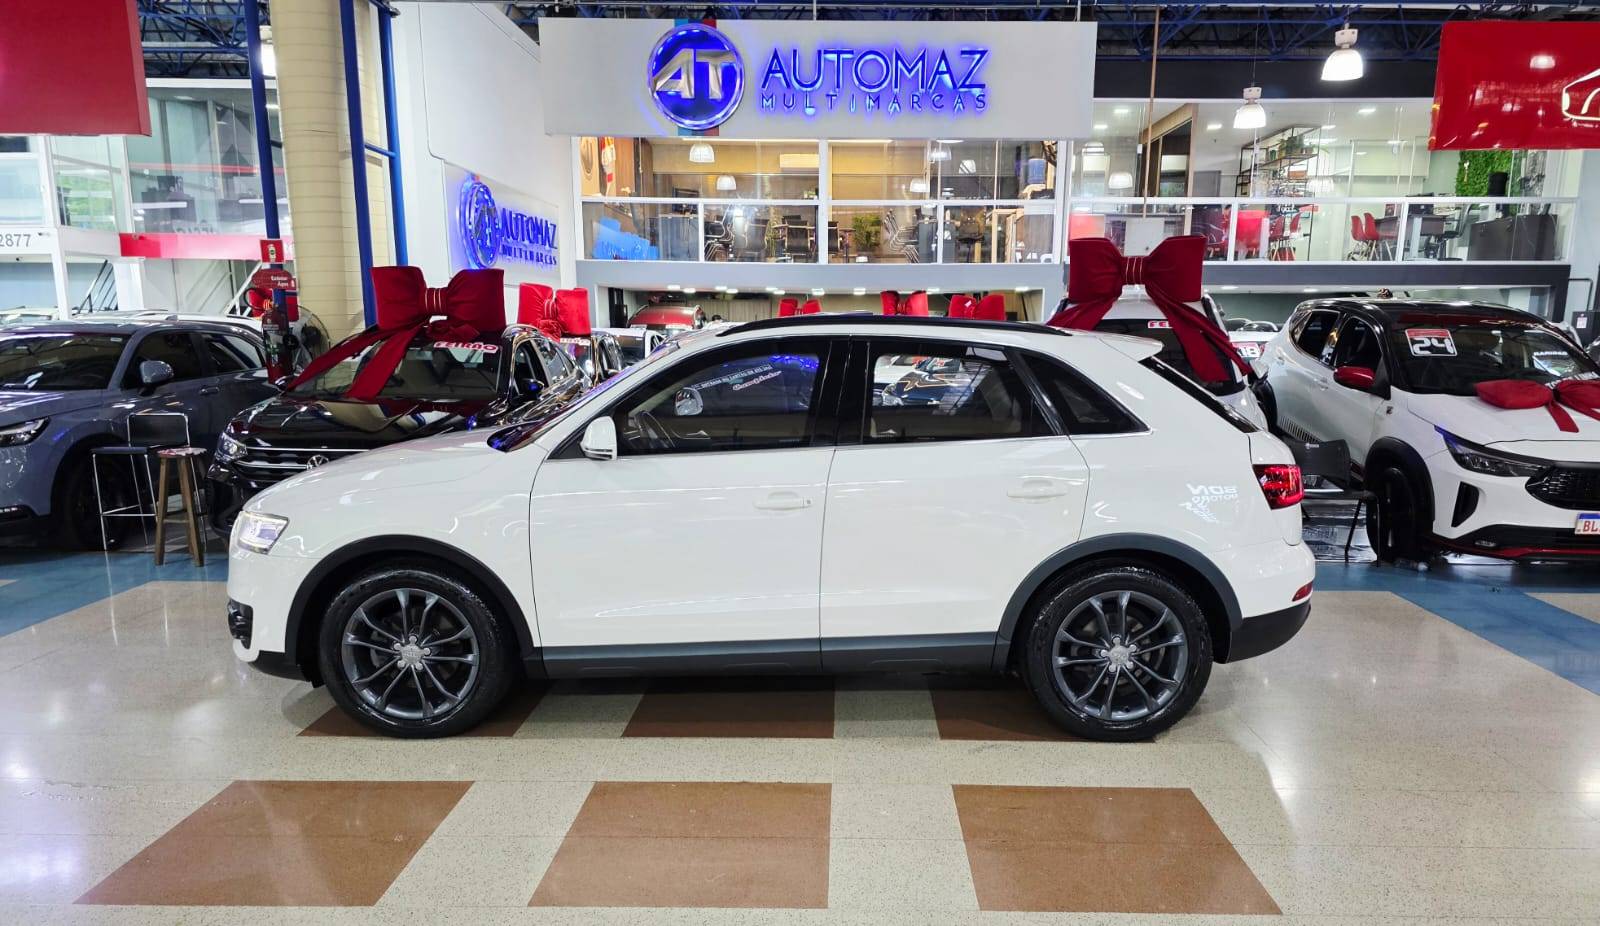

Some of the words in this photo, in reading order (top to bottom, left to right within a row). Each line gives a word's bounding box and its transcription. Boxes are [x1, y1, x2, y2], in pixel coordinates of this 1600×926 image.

[652, 47, 736, 99] AT
[761, 47, 988, 91] AUTOMAZ
[761, 92, 987, 112] MULTIMARCAS
[500, 207, 558, 249] AUTOMAZ
[1413, 337, 1454, 355] 24
[1583, 520, 1600, 533] BL
